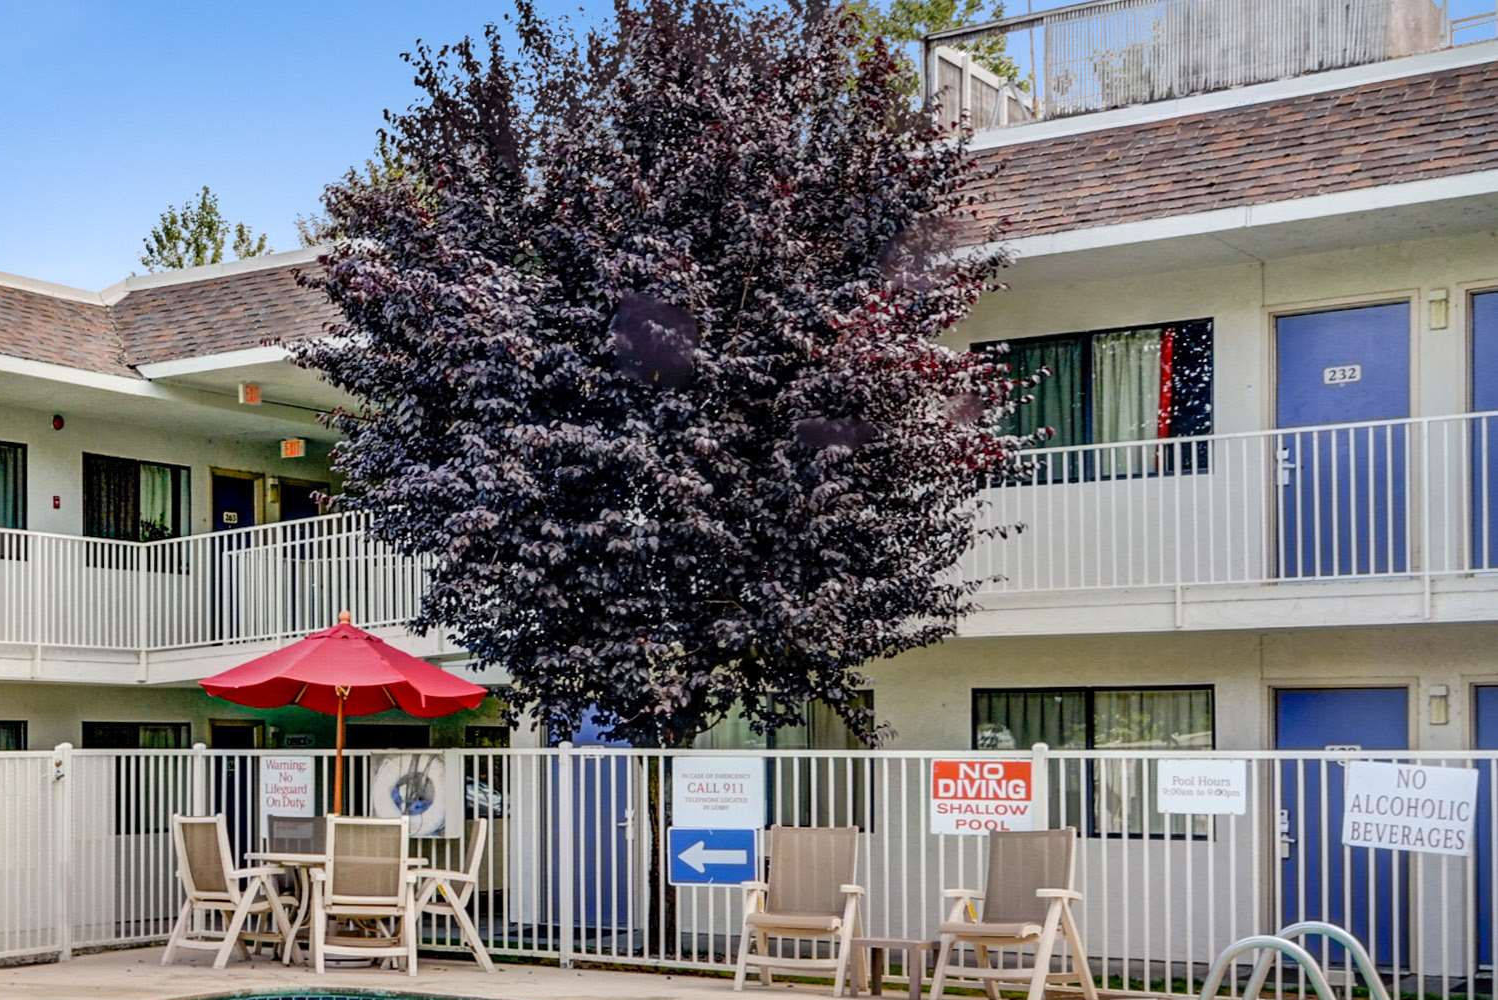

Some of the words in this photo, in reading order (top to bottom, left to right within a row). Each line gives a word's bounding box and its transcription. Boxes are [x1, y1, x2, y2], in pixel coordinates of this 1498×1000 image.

[1327, 367, 1358, 382] 232
[278, 772, 293, 782] No
[958, 763, 1004, 780] NO
[1172, 775, 1195, 786] Pool
[1198, 775, 1231, 787] Hours
[1396, 769, 1427, 790] NO
[265, 784, 308, 796] Lifeguard
[687, 782, 720, 794] CALL
[722, 783, 744, 793] 911
[937, 778, 1027, 800] DIVING
[266, 797, 281, 807] On
[1350, 793, 1470, 822] ALCOHOLIC
[936, 803, 1029, 816] SHALLOW
[955, 819, 1010, 832] POOL
[1350, 821, 1466, 850] BEVERAGES
